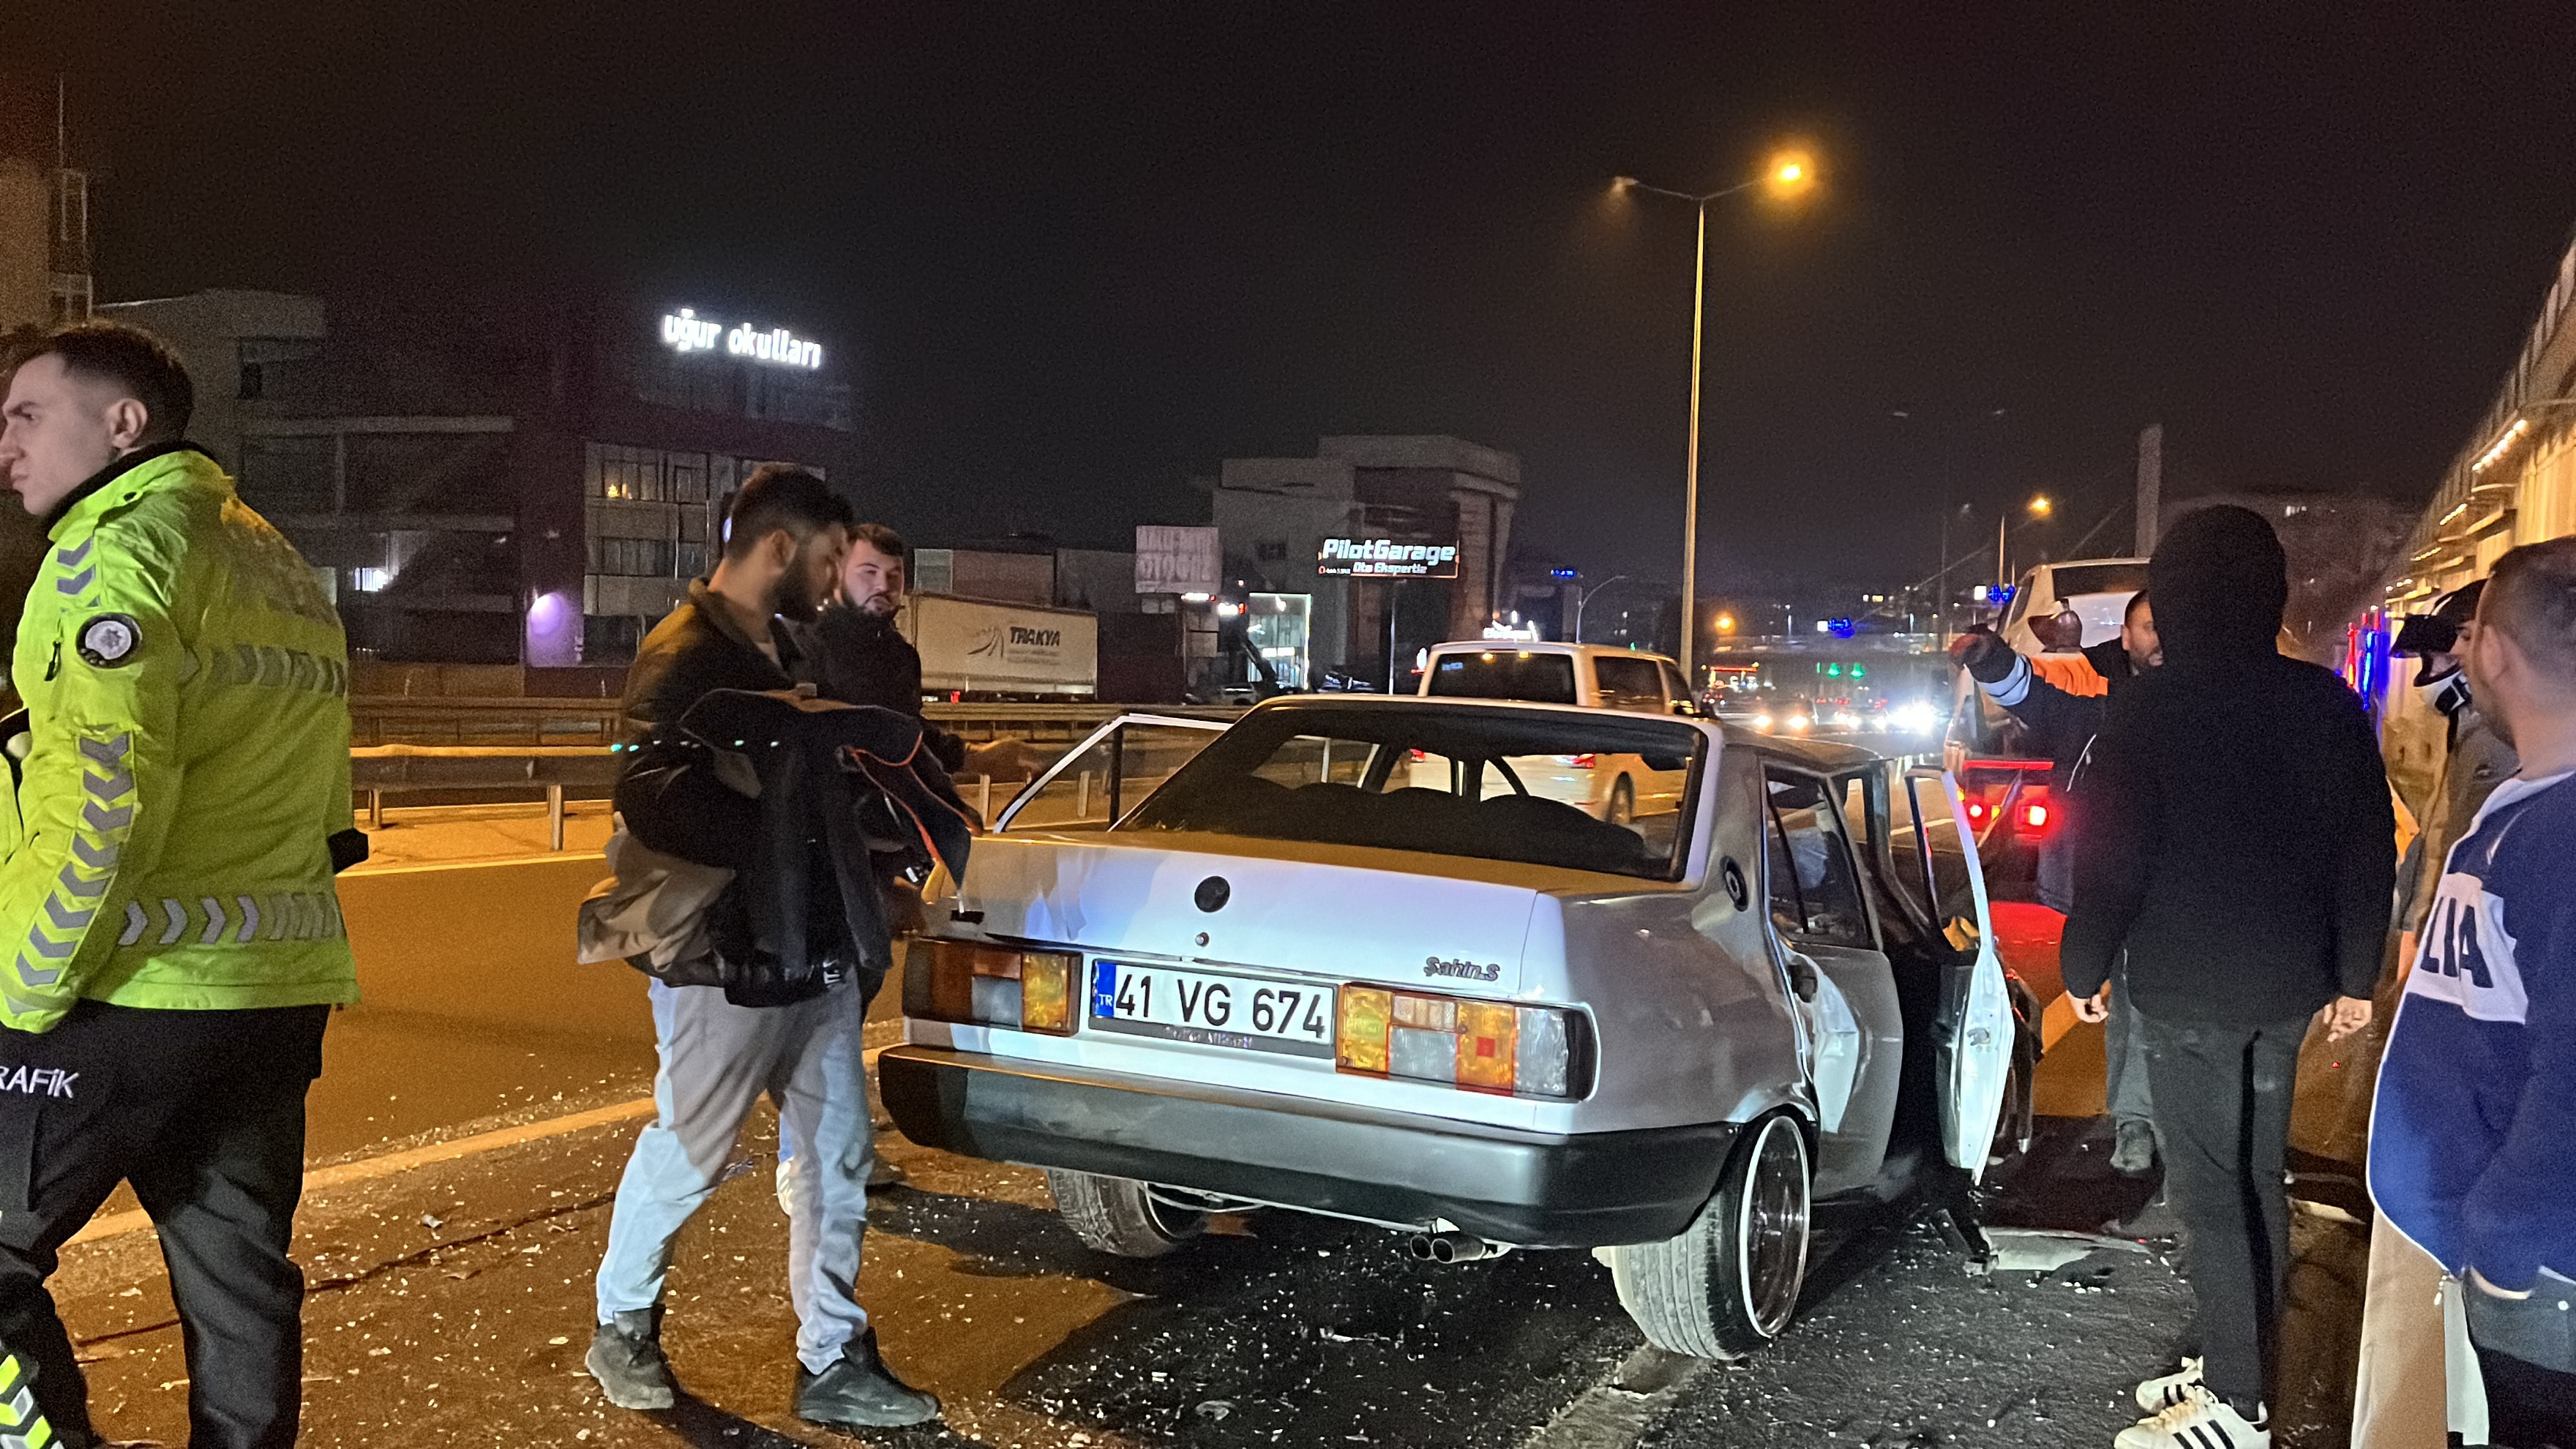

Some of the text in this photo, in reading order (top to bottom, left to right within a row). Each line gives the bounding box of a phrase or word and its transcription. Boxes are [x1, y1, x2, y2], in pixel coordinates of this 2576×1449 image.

[664, 308, 821, 368] uğur okulları
[1322, 539, 1456, 566] PilotGarage
[1352, 562, 1373, 573] Oto
[1010, 626, 1060, 646] TRAKYA
[1098, 993, 1114, 1007] TR
[1115, 974, 1151, 1018] 41
[1177, 979, 1232, 1026] VG
[1252, 988, 1325, 1039] 674
